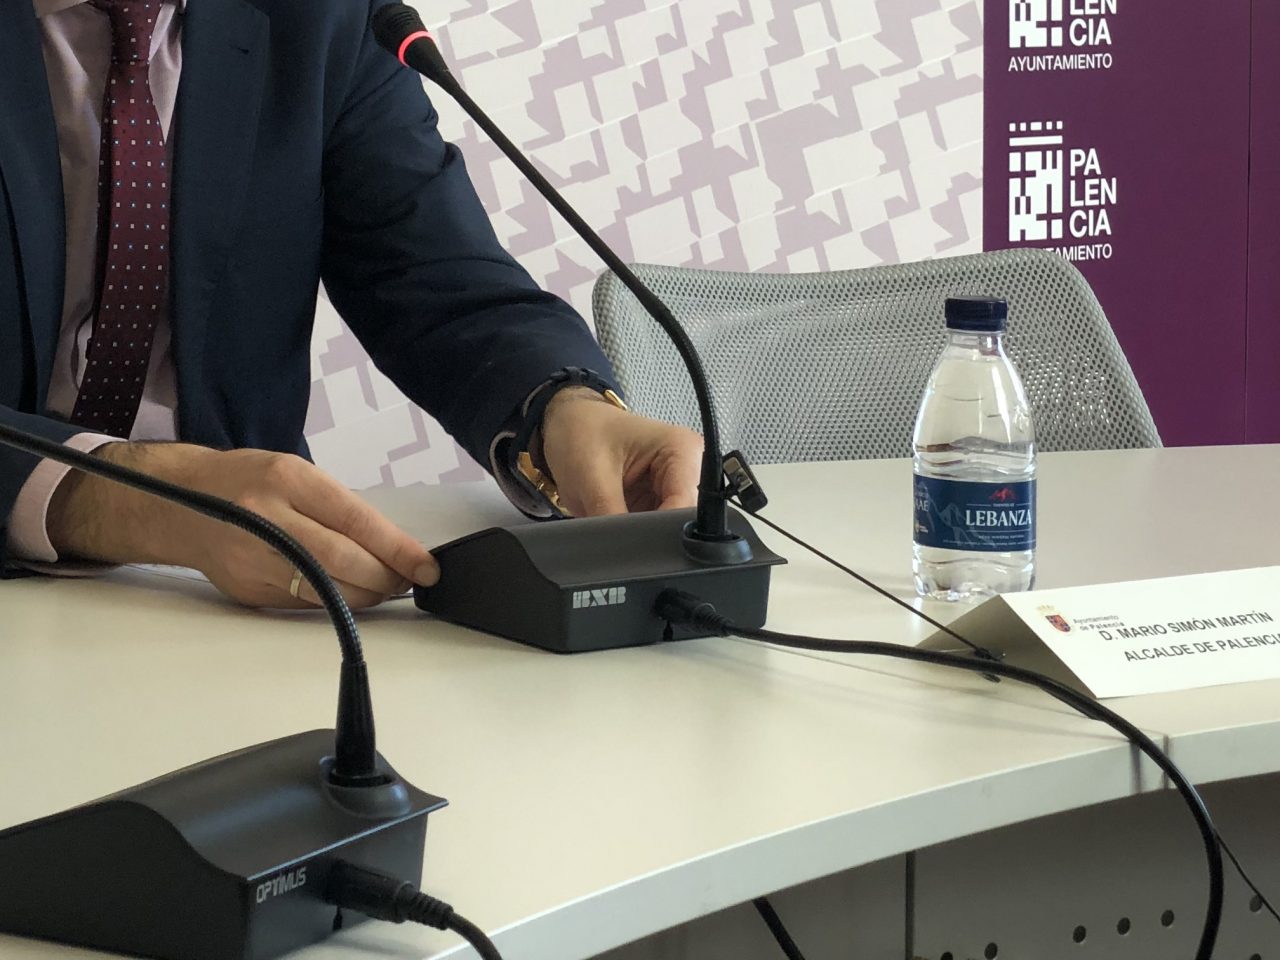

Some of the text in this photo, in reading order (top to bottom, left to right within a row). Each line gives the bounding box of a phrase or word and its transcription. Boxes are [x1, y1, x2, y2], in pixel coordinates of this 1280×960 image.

[1070, 18, 1112, 46] CIA
[1007, 52, 1113, 72] AYUNTAMIENTO
[1070, 148, 1102, 176] PA
[1070, 177, 1117, 207] LEN
[1070, 209, 1112, 238] CIA
[965, 509, 1032, 527] LEBANZA
[1099, 610, 1274, 641] D. MARIO SIMÓN MARTÍN
[1124, 644, 1195, 662] ALCALDE
[1193, 641, 1218, 653] DE
[256, 866, 307, 904] OPTIMUS
